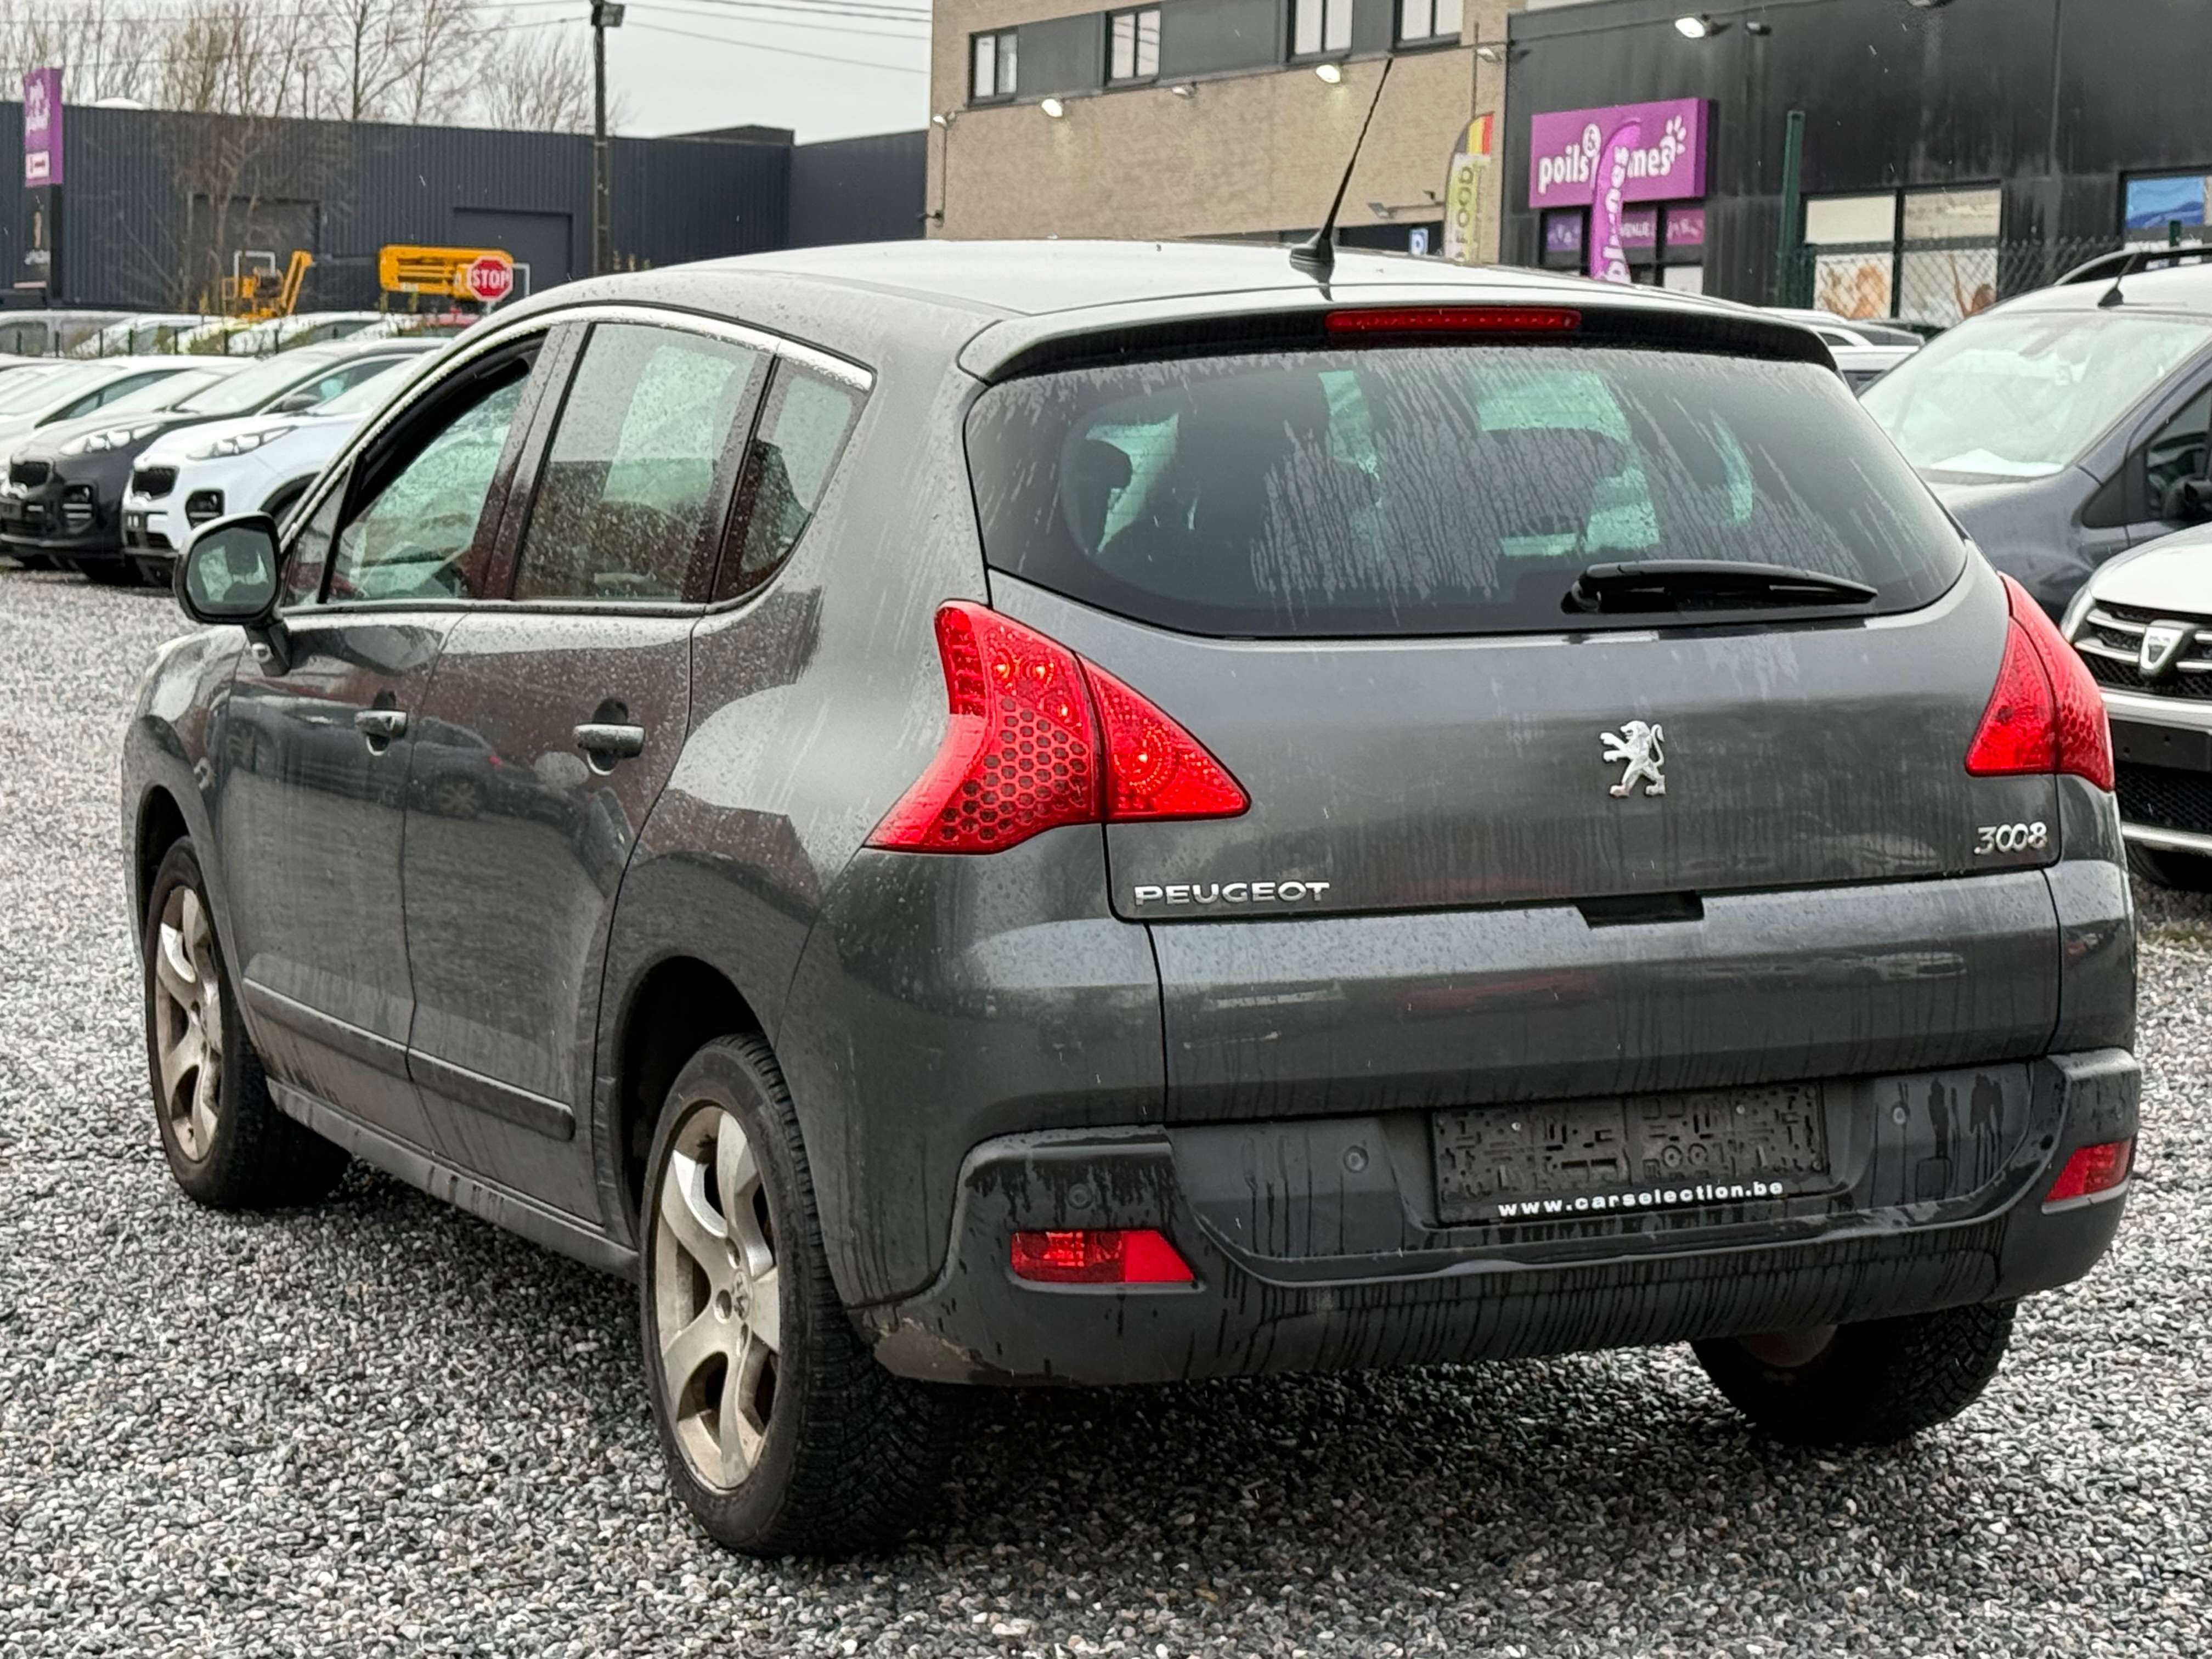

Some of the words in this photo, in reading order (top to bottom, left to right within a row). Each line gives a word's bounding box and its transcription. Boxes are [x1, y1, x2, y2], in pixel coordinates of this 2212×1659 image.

[1538, 143, 1589, 194] poils
[472, 269, 510, 289] STOP
[1974, 822, 2047, 854] 3008
[1134, 881, 1330, 906] PEUGEOT
[1498, 1181, 1784, 1217] www.carselection.be
